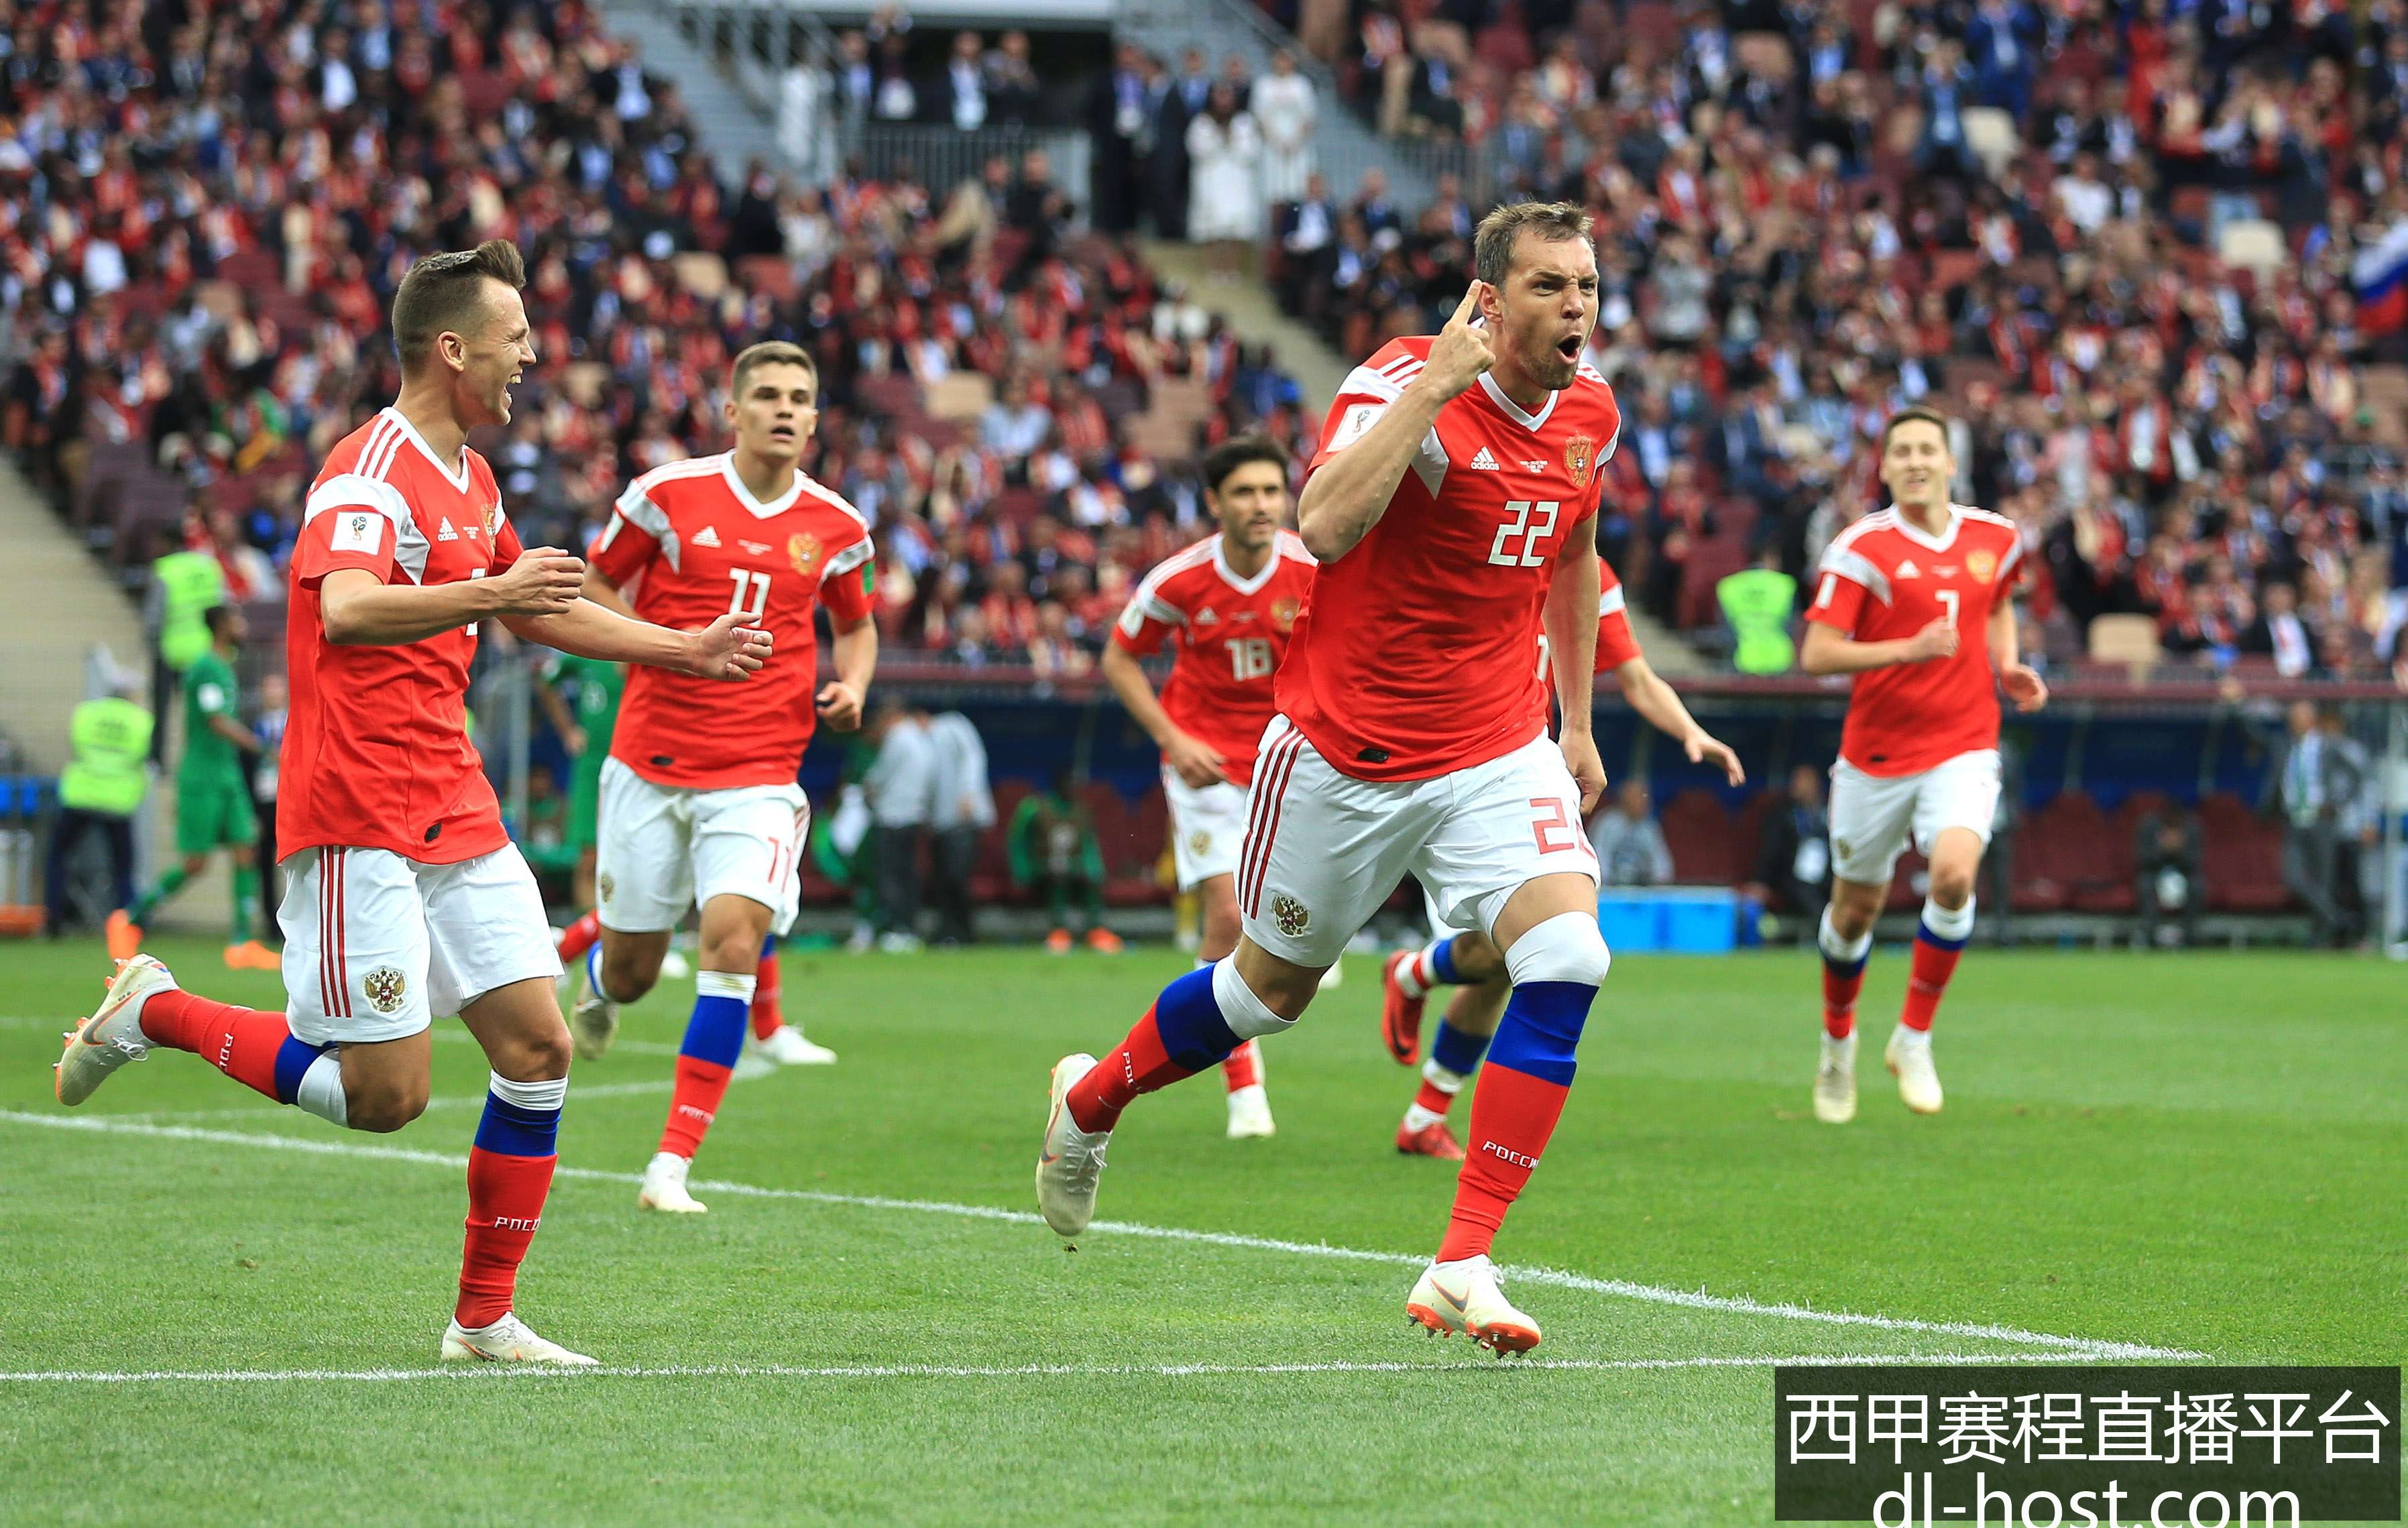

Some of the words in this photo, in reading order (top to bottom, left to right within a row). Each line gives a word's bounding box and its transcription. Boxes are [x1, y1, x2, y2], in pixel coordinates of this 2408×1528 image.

[1470, 461, 1500, 471] adidas
[1487, 500, 1560, 567] 22
[729, 567, 772, 628] 11
[1223, 638, 1273, 682] 18
